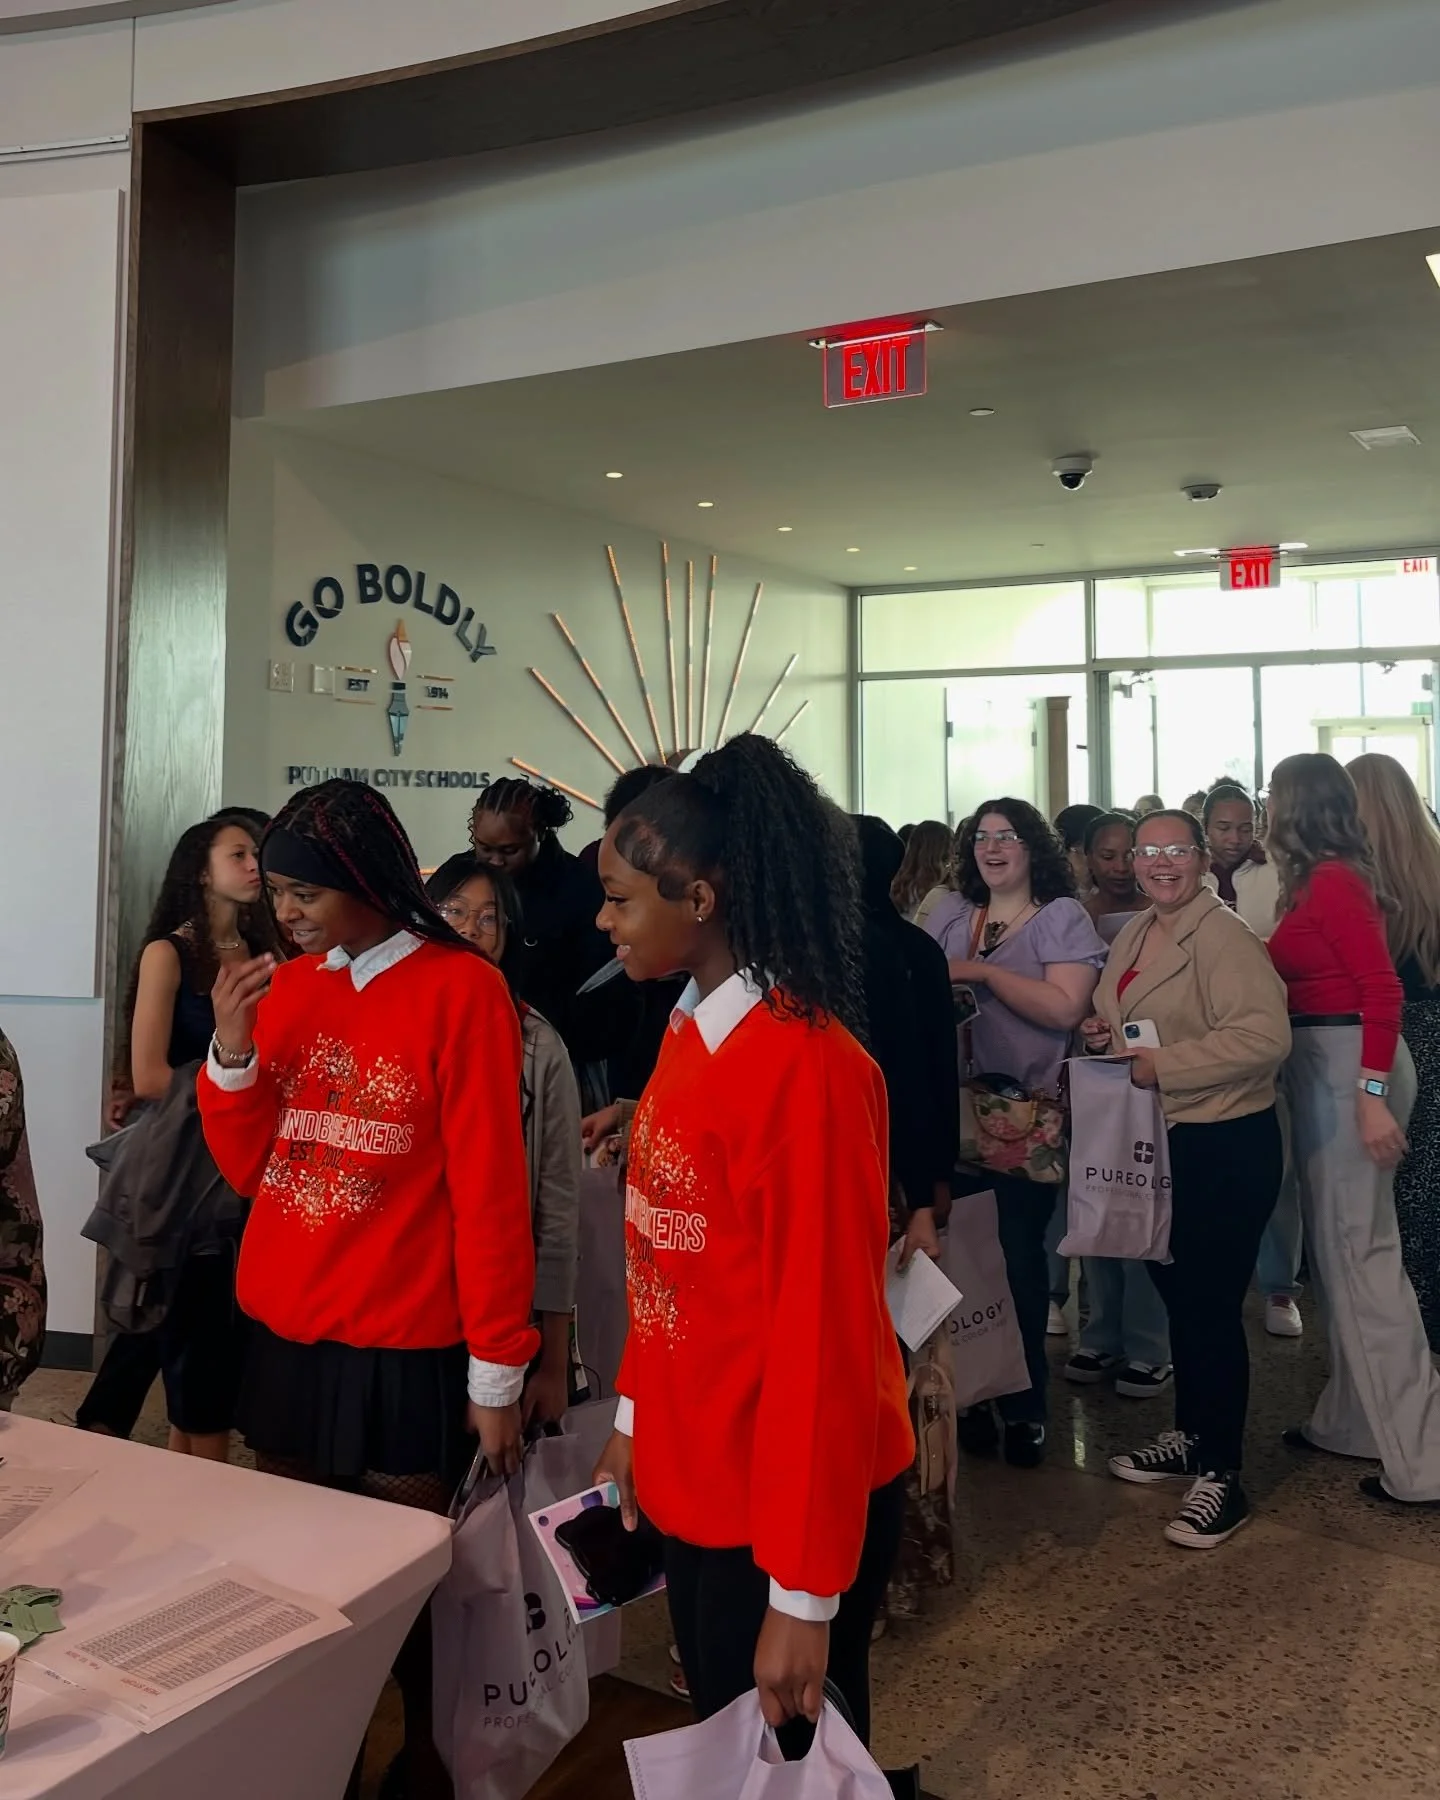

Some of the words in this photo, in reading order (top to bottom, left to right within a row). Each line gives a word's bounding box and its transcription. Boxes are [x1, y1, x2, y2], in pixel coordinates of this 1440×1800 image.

[843, 335, 910, 399] EXIT
[1229, 557, 1272, 590] EXIT
[285, 576, 344, 647] GO
[355, 563, 497, 663] BOLDLY
[347, 678, 370, 692] EST
[373, 769, 411, 786] CITY
[415, 771, 490, 788] SCHOOLS
